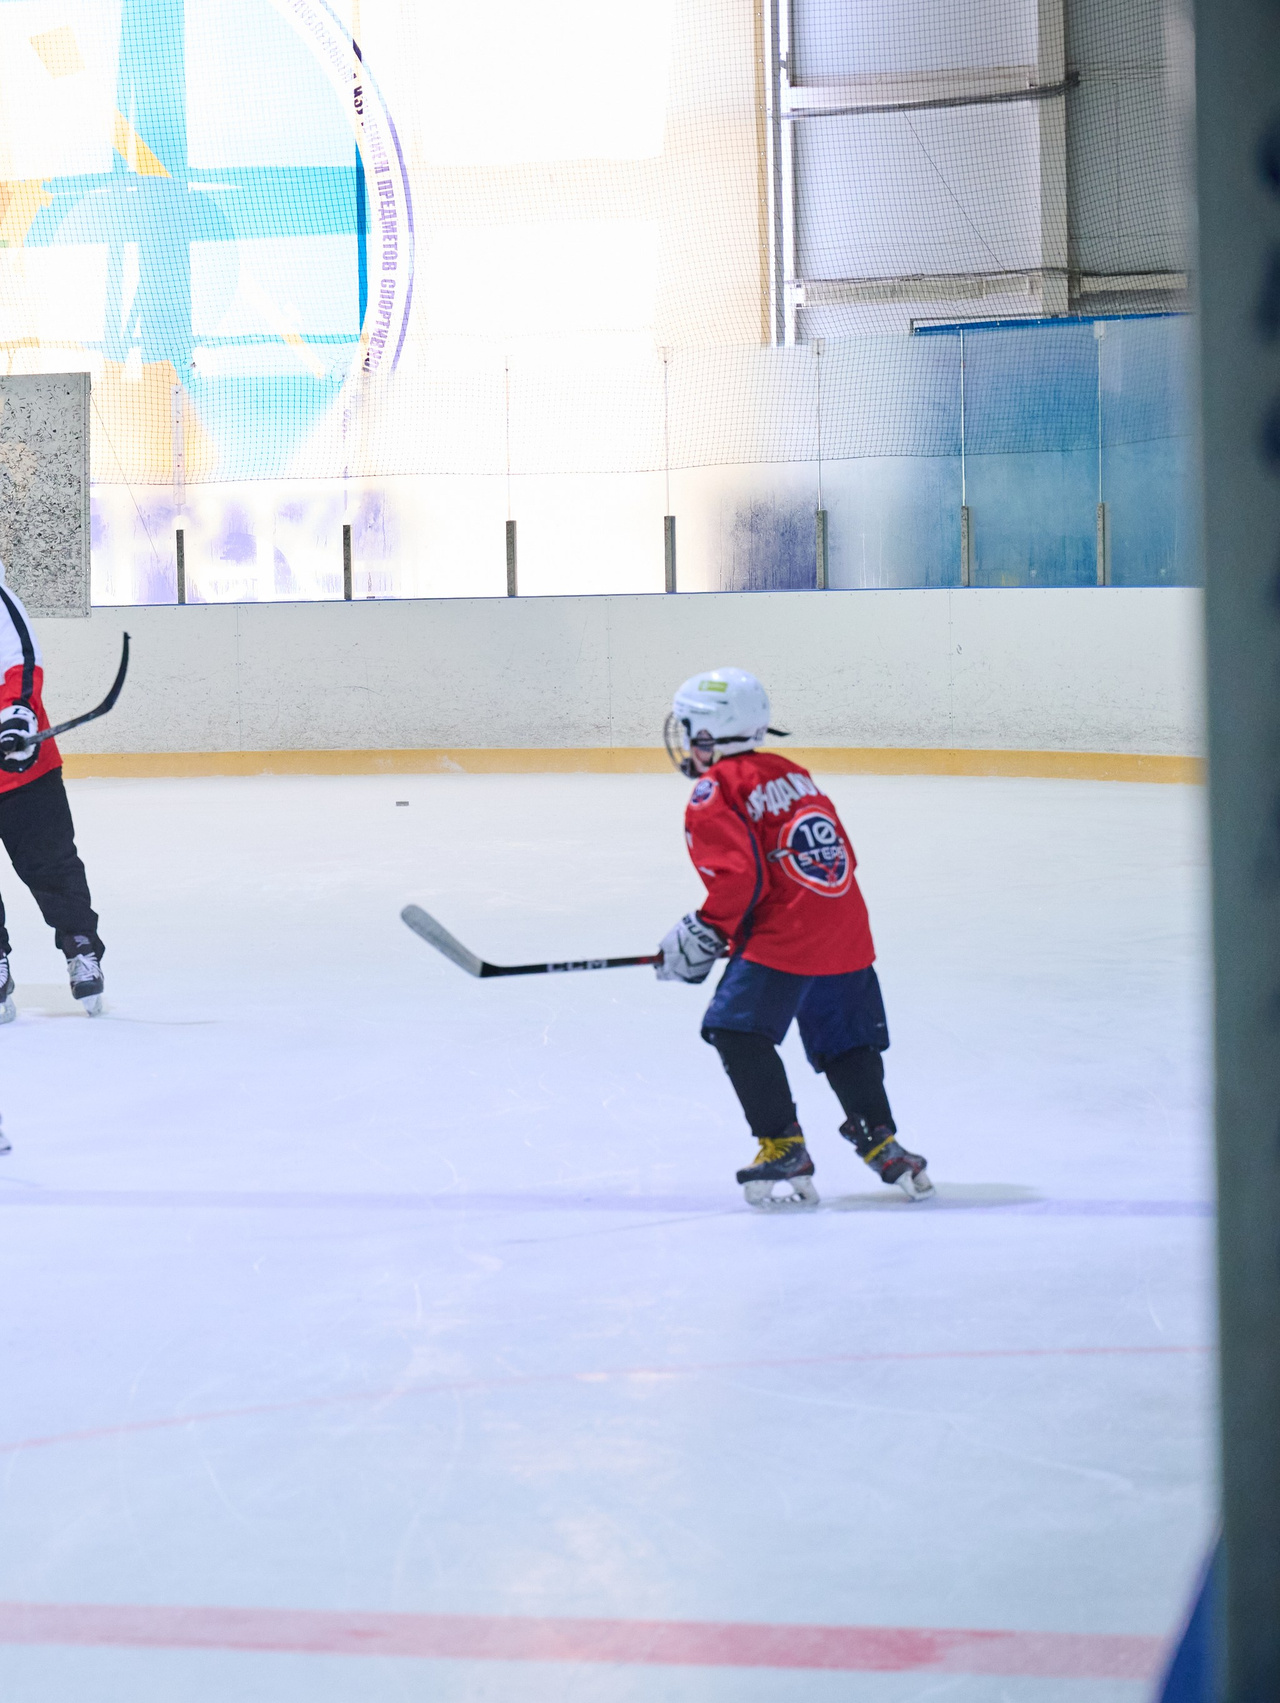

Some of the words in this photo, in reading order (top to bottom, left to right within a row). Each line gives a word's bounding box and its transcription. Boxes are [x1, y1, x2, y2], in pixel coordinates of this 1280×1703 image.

[376, 178, 399, 272] ПРЕДМЕТОВ
[799, 821, 837, 848] 10
[682, 914, 724, 950] AUER
[547, 959, 608, 973] CCM
